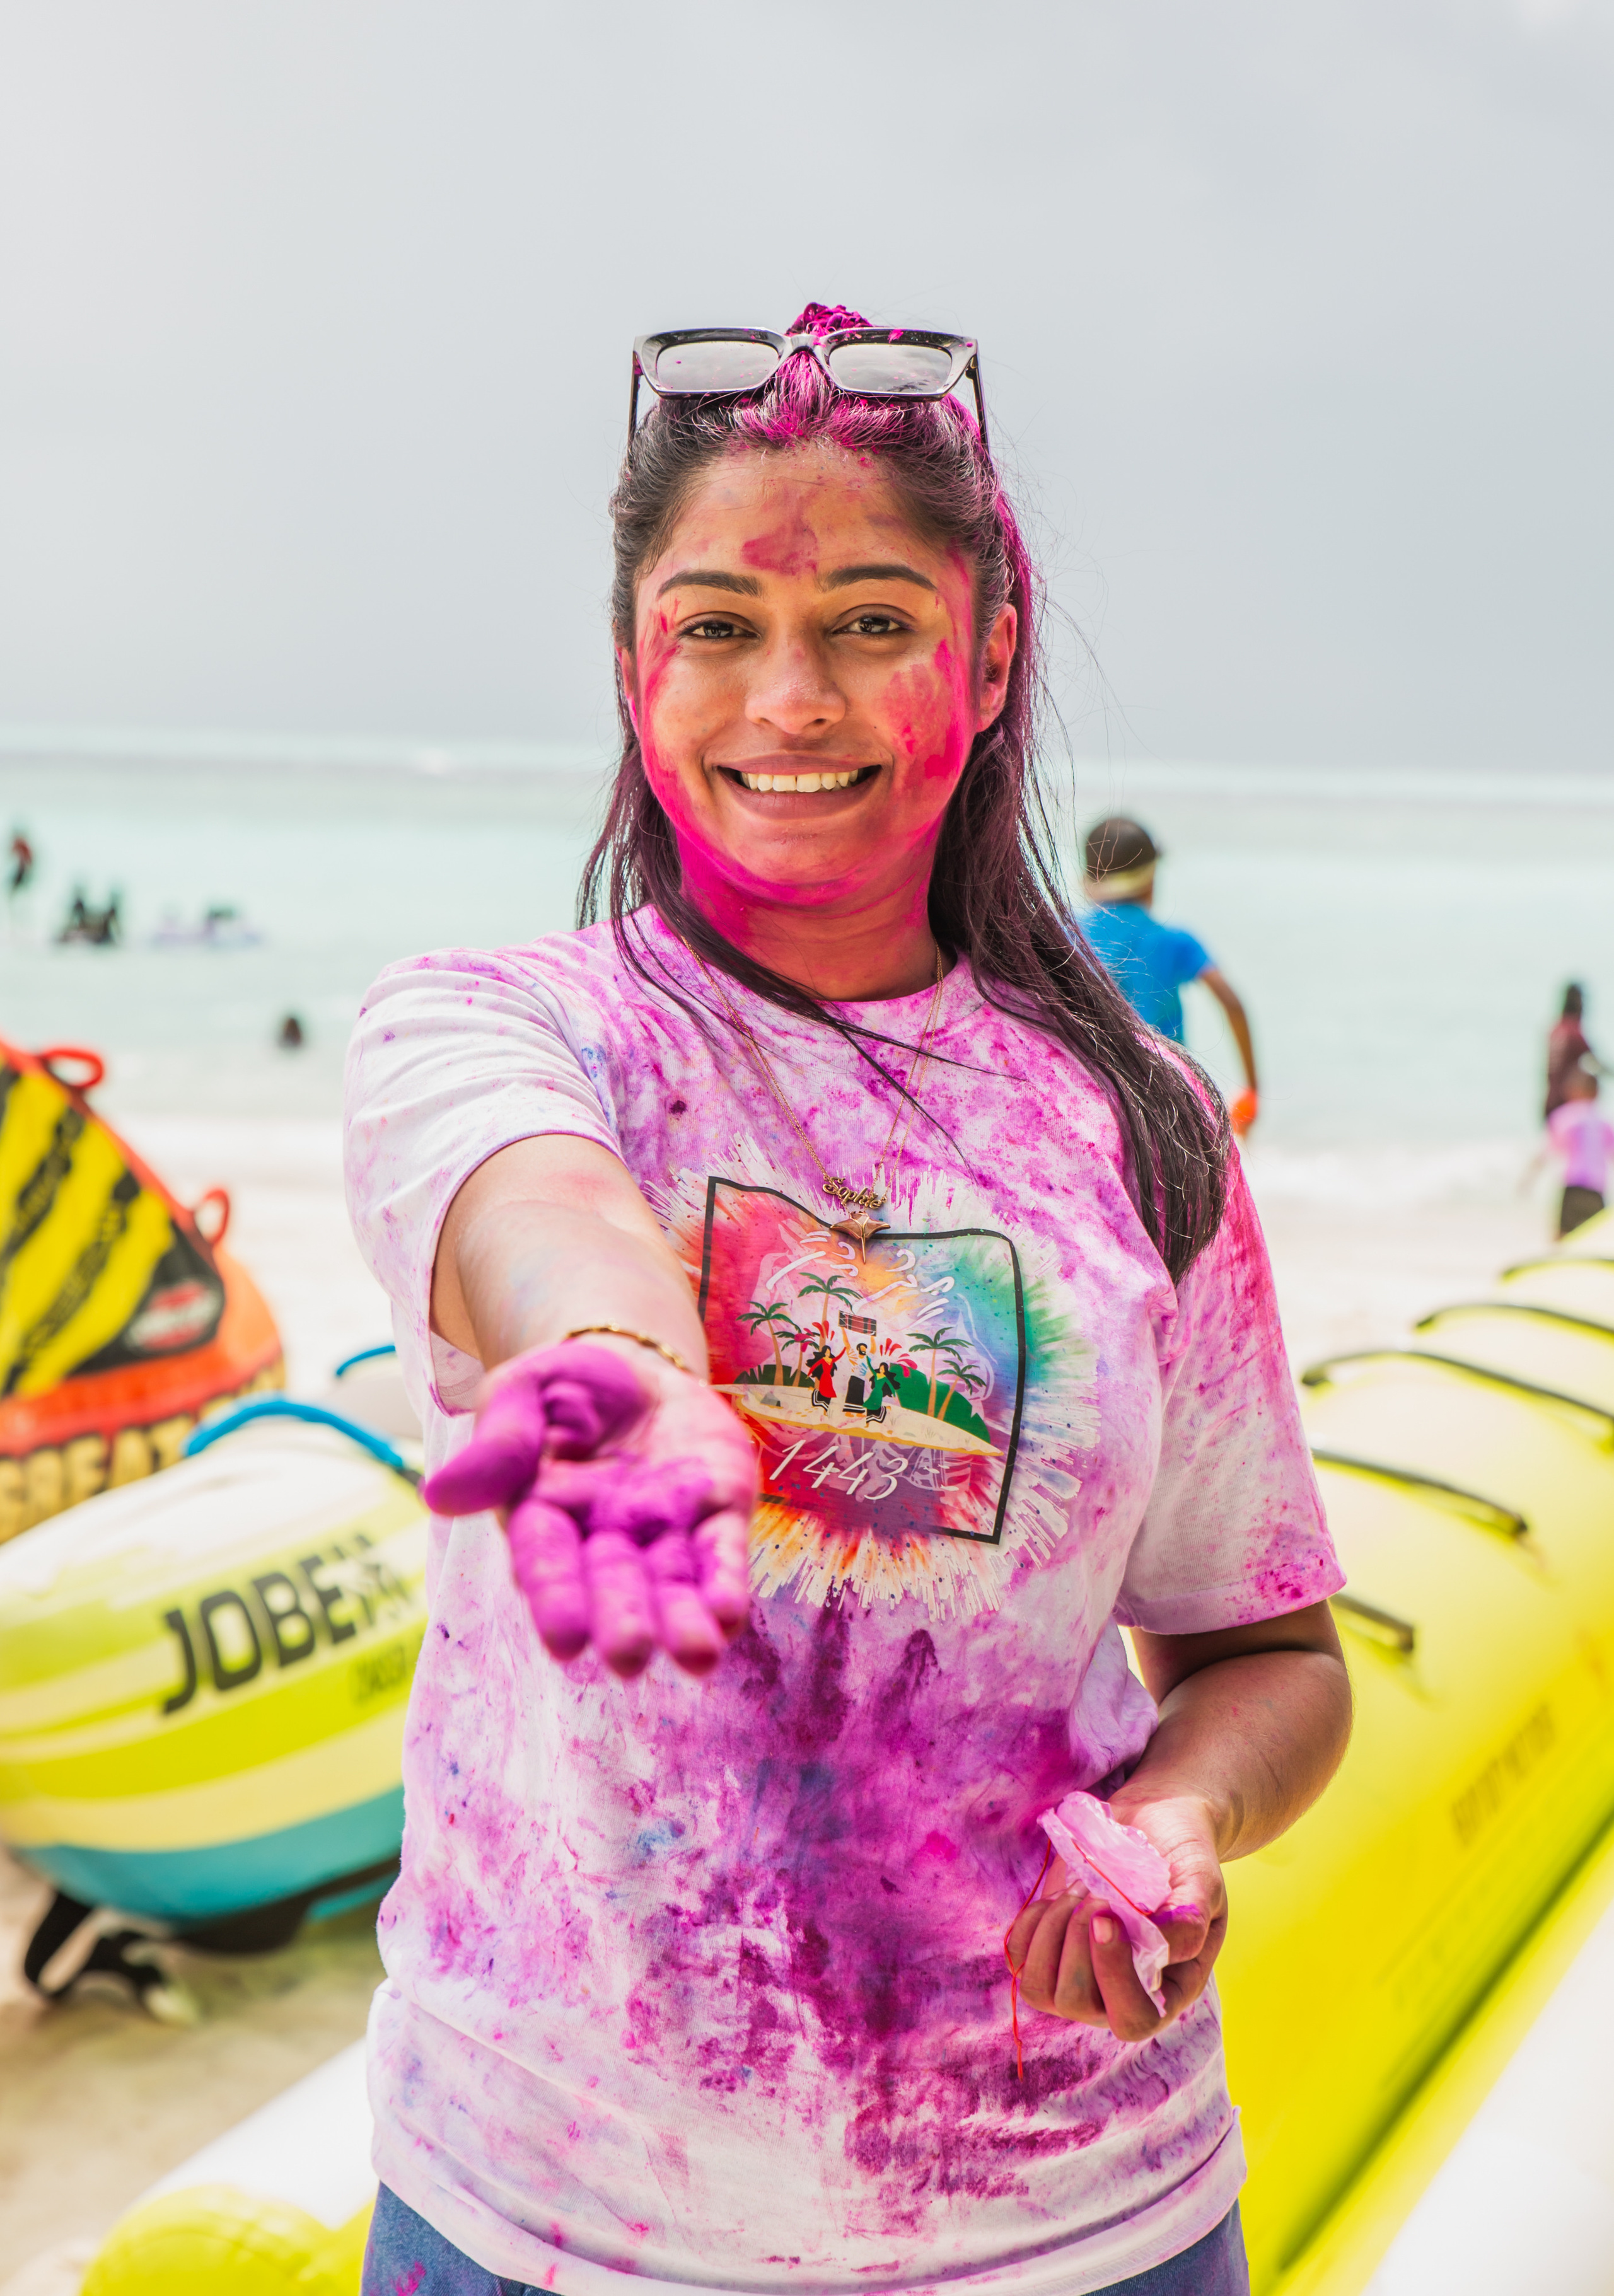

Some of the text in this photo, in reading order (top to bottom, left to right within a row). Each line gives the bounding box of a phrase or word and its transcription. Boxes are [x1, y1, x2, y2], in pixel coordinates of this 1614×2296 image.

[822, 1176, 882, 1209] Sophie
[769, 1439, 909, 1500] 1443
[162, 1553, 357, 1717] JOBE
